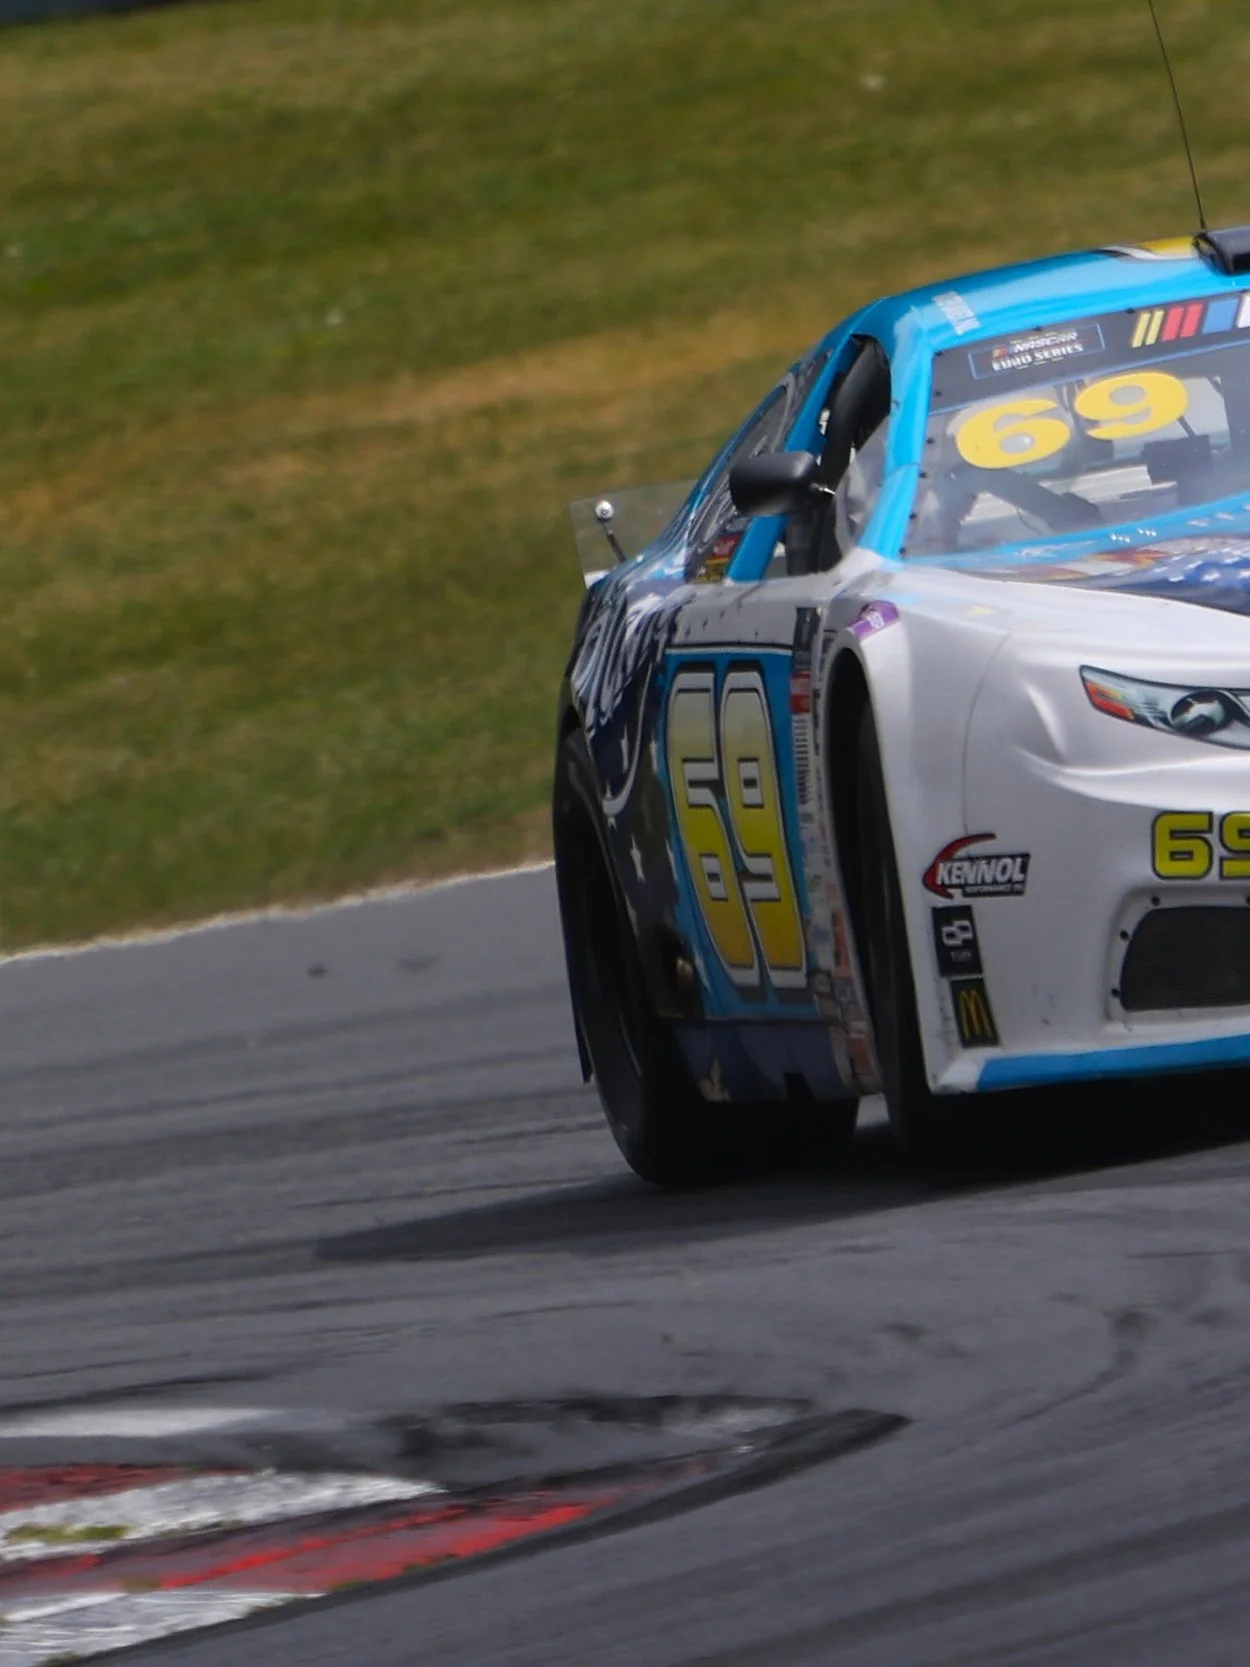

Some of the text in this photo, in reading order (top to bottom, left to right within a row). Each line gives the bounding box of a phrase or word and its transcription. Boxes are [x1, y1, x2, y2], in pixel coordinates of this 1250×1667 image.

[955, 371, 1188, 469] 69
[665, 662, 808, 990] 69
[936, 857, 1027, 886] KENNOL
